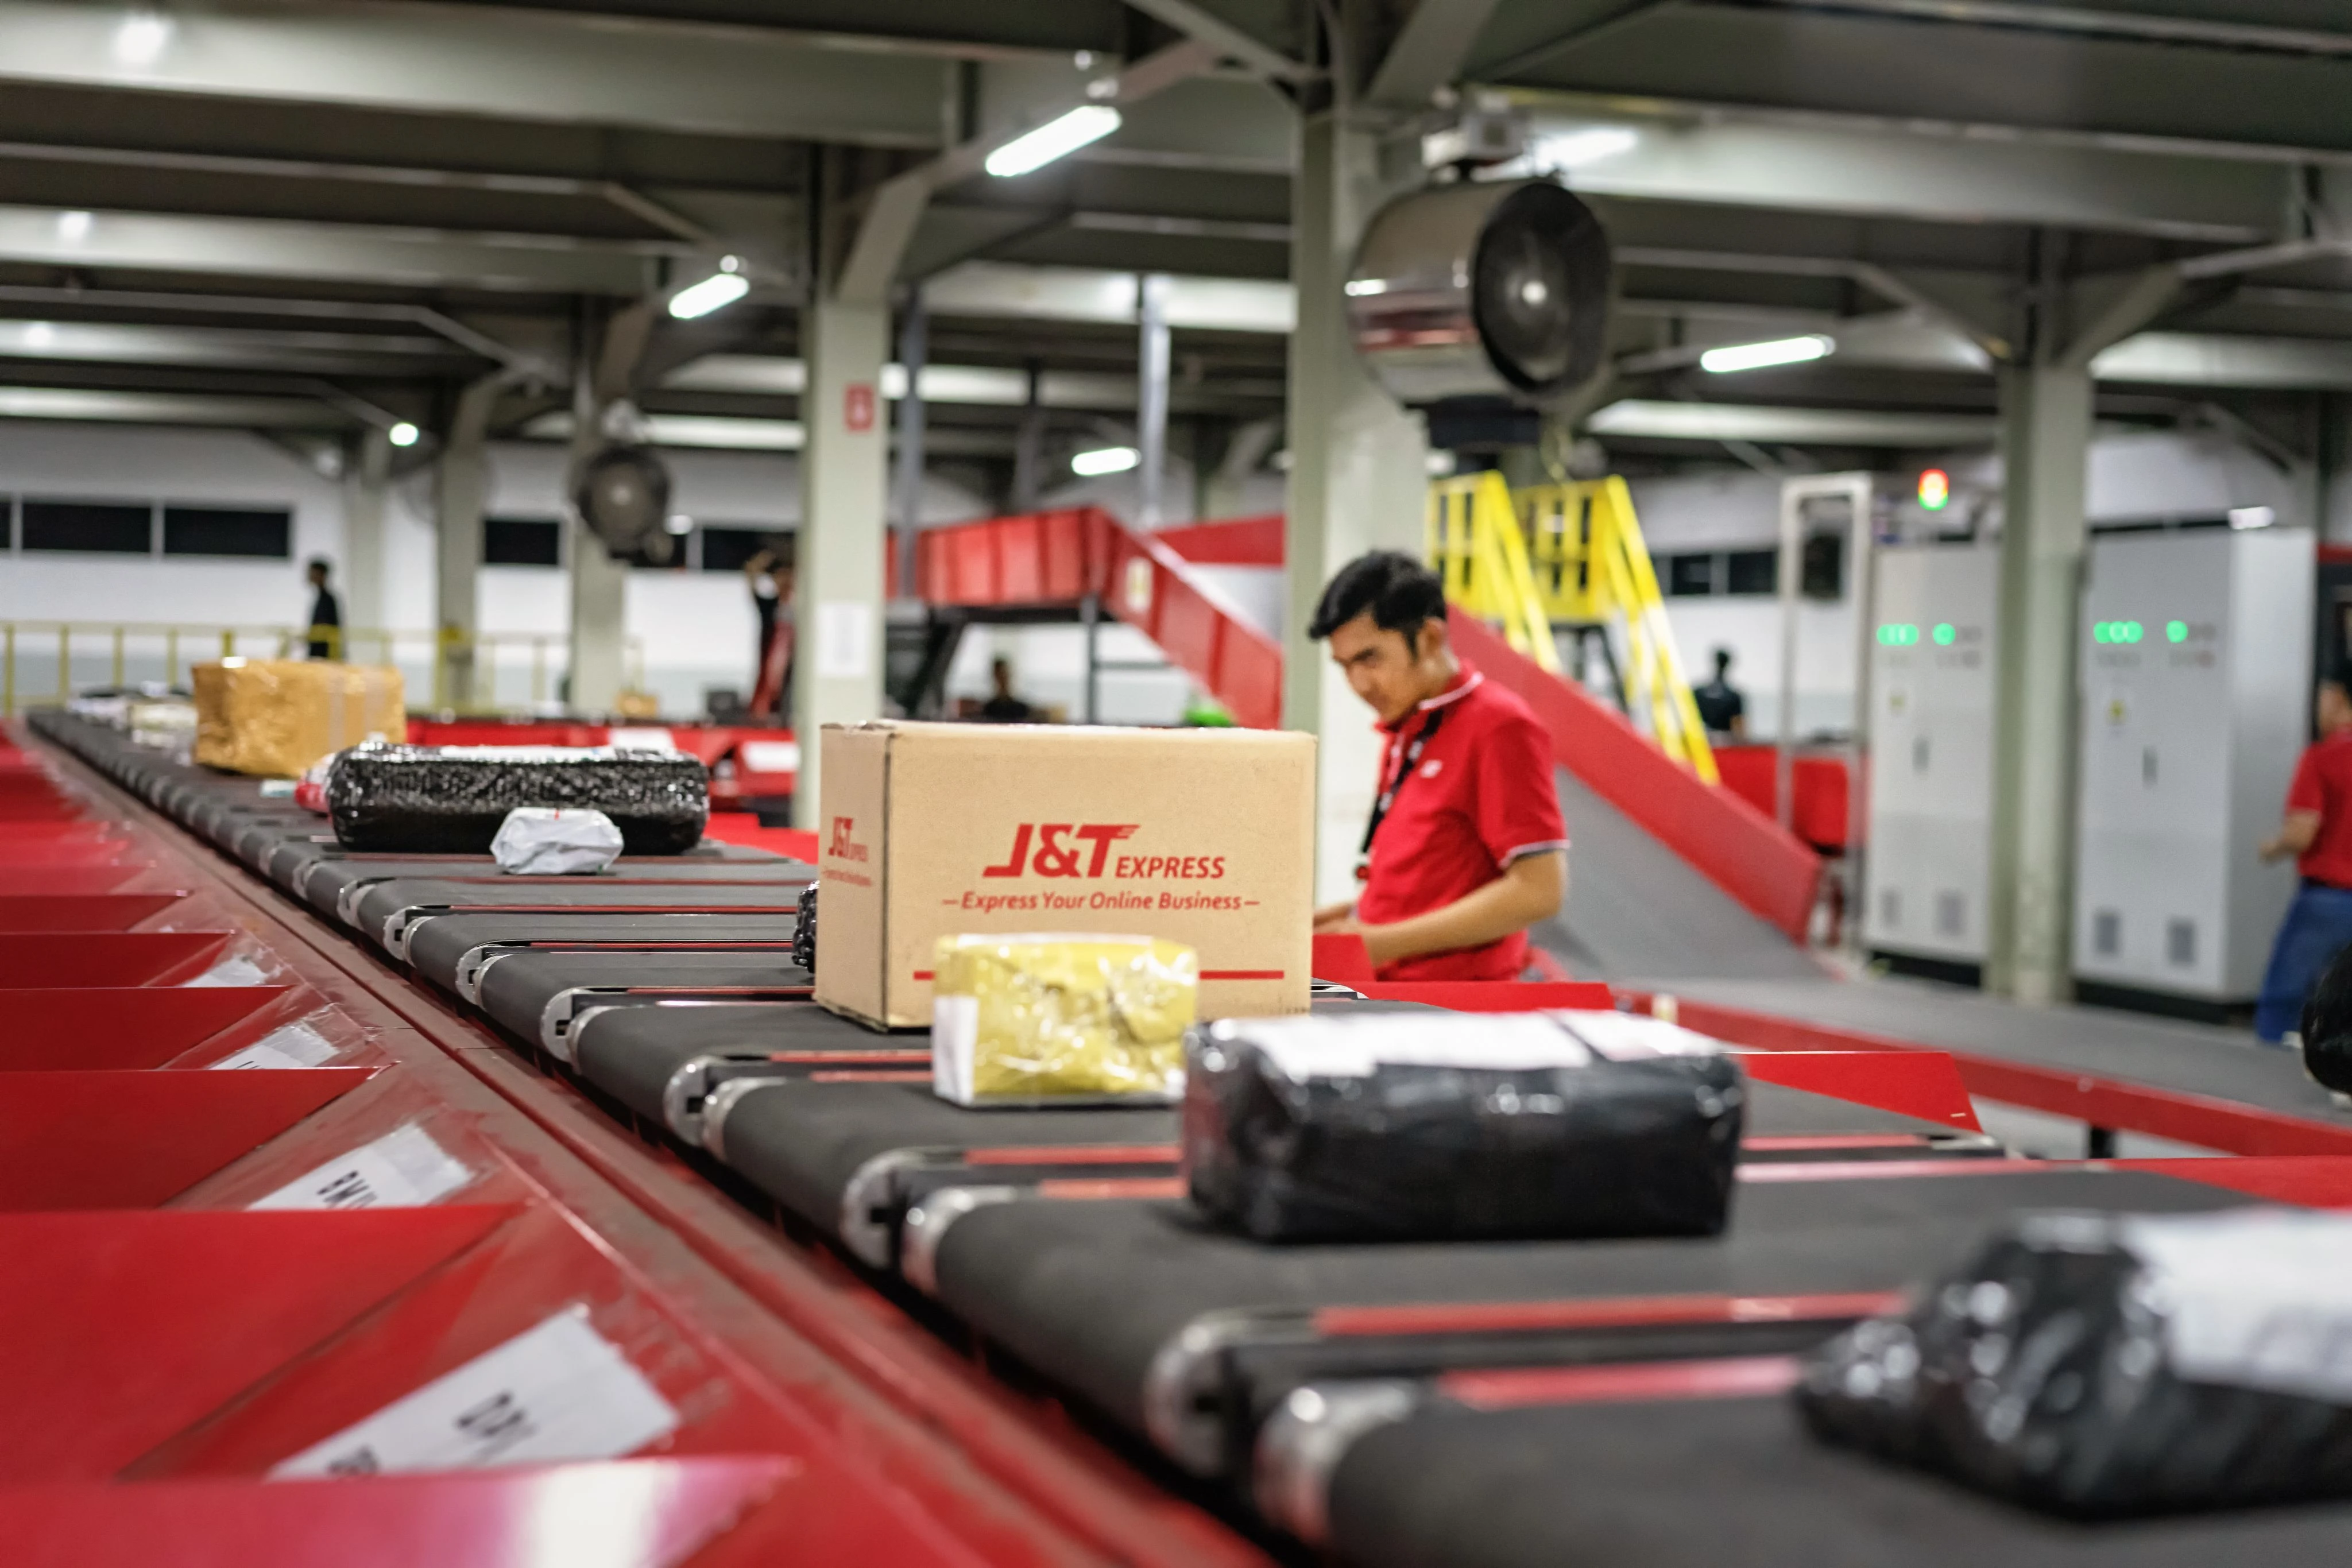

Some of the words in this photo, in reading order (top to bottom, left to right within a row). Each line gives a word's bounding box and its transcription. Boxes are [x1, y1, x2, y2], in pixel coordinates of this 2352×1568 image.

[981, 823, 1140, 878] J&T
[1115, 856, 1225, 879] EXPRESS
[1043, 892, 1085, 909] Your
[1090, 892, 1154, 909] Online
